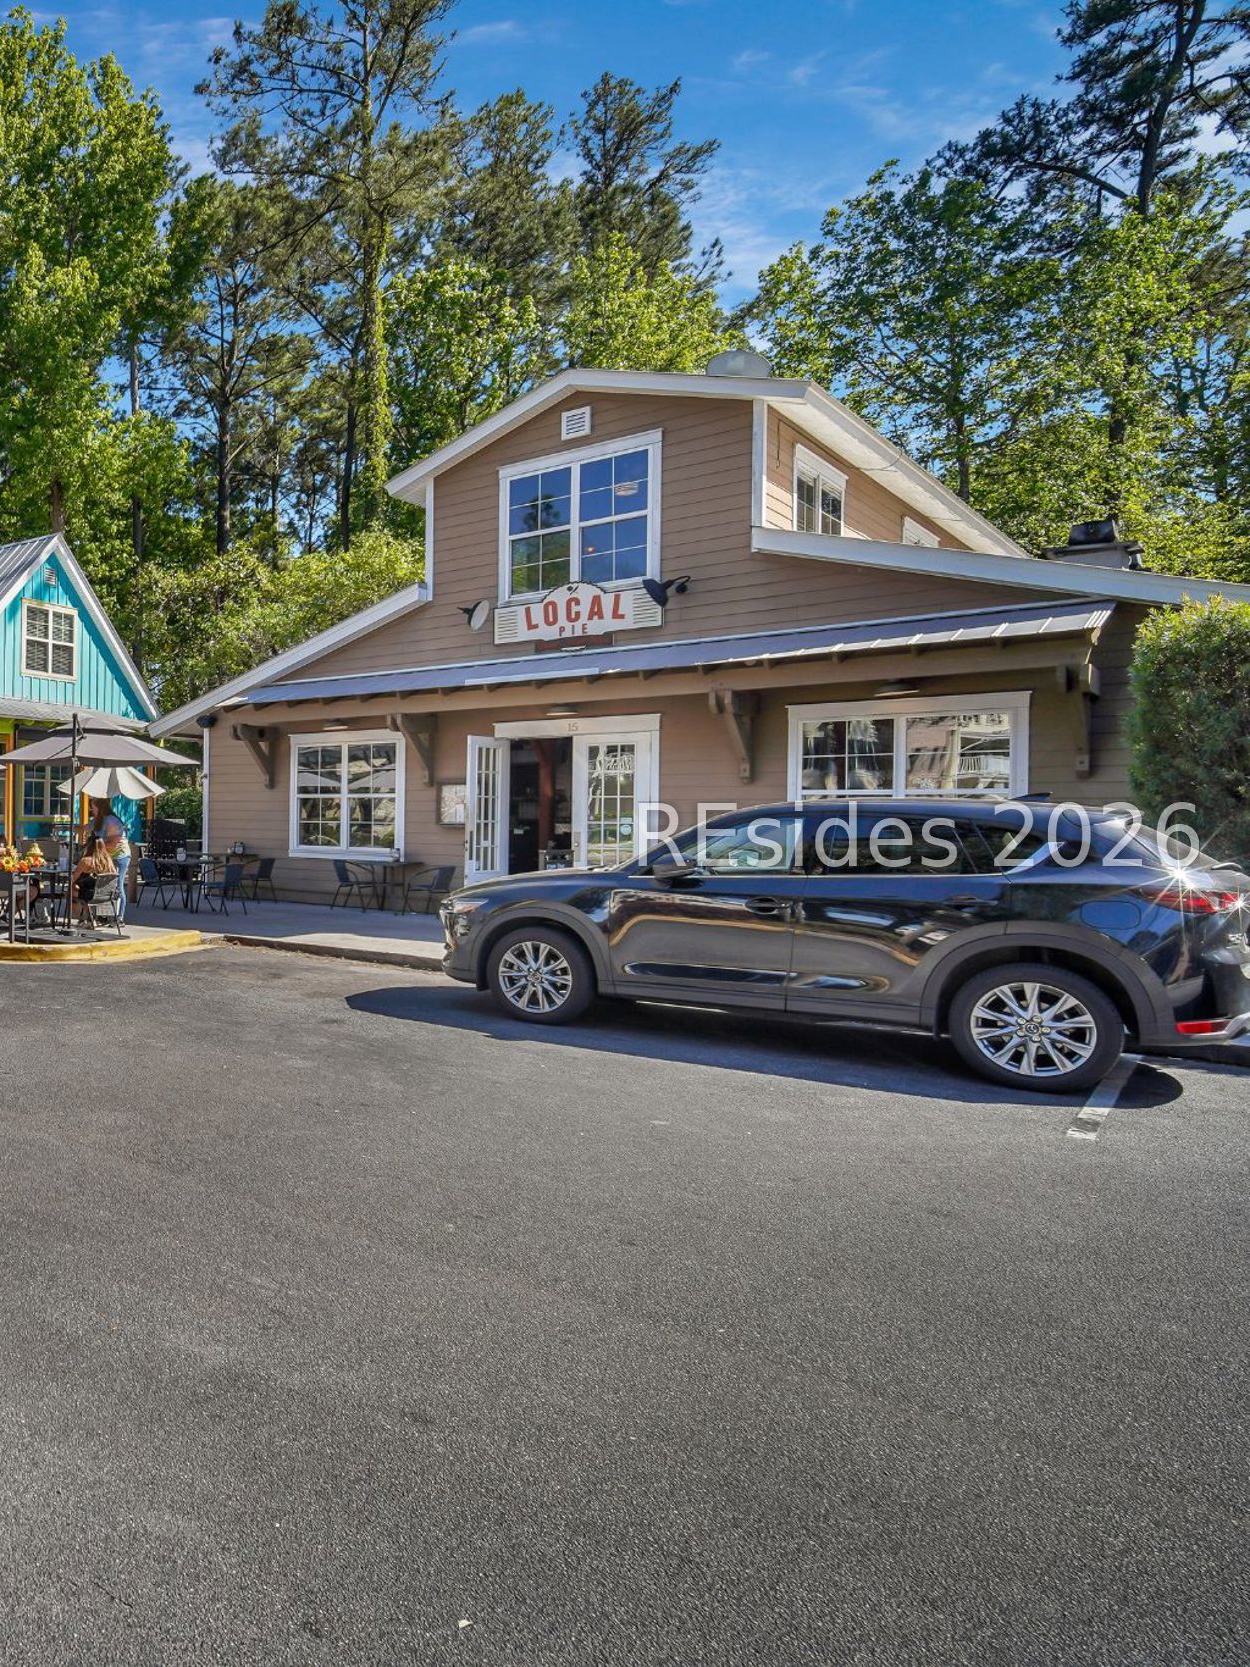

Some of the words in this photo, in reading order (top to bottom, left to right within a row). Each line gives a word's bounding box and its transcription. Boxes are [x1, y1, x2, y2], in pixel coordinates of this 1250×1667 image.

[524, 593, 626, 631] LOCAL
[558, 623, 588, 637] PIE
[567, 721, 579, 732] 15
